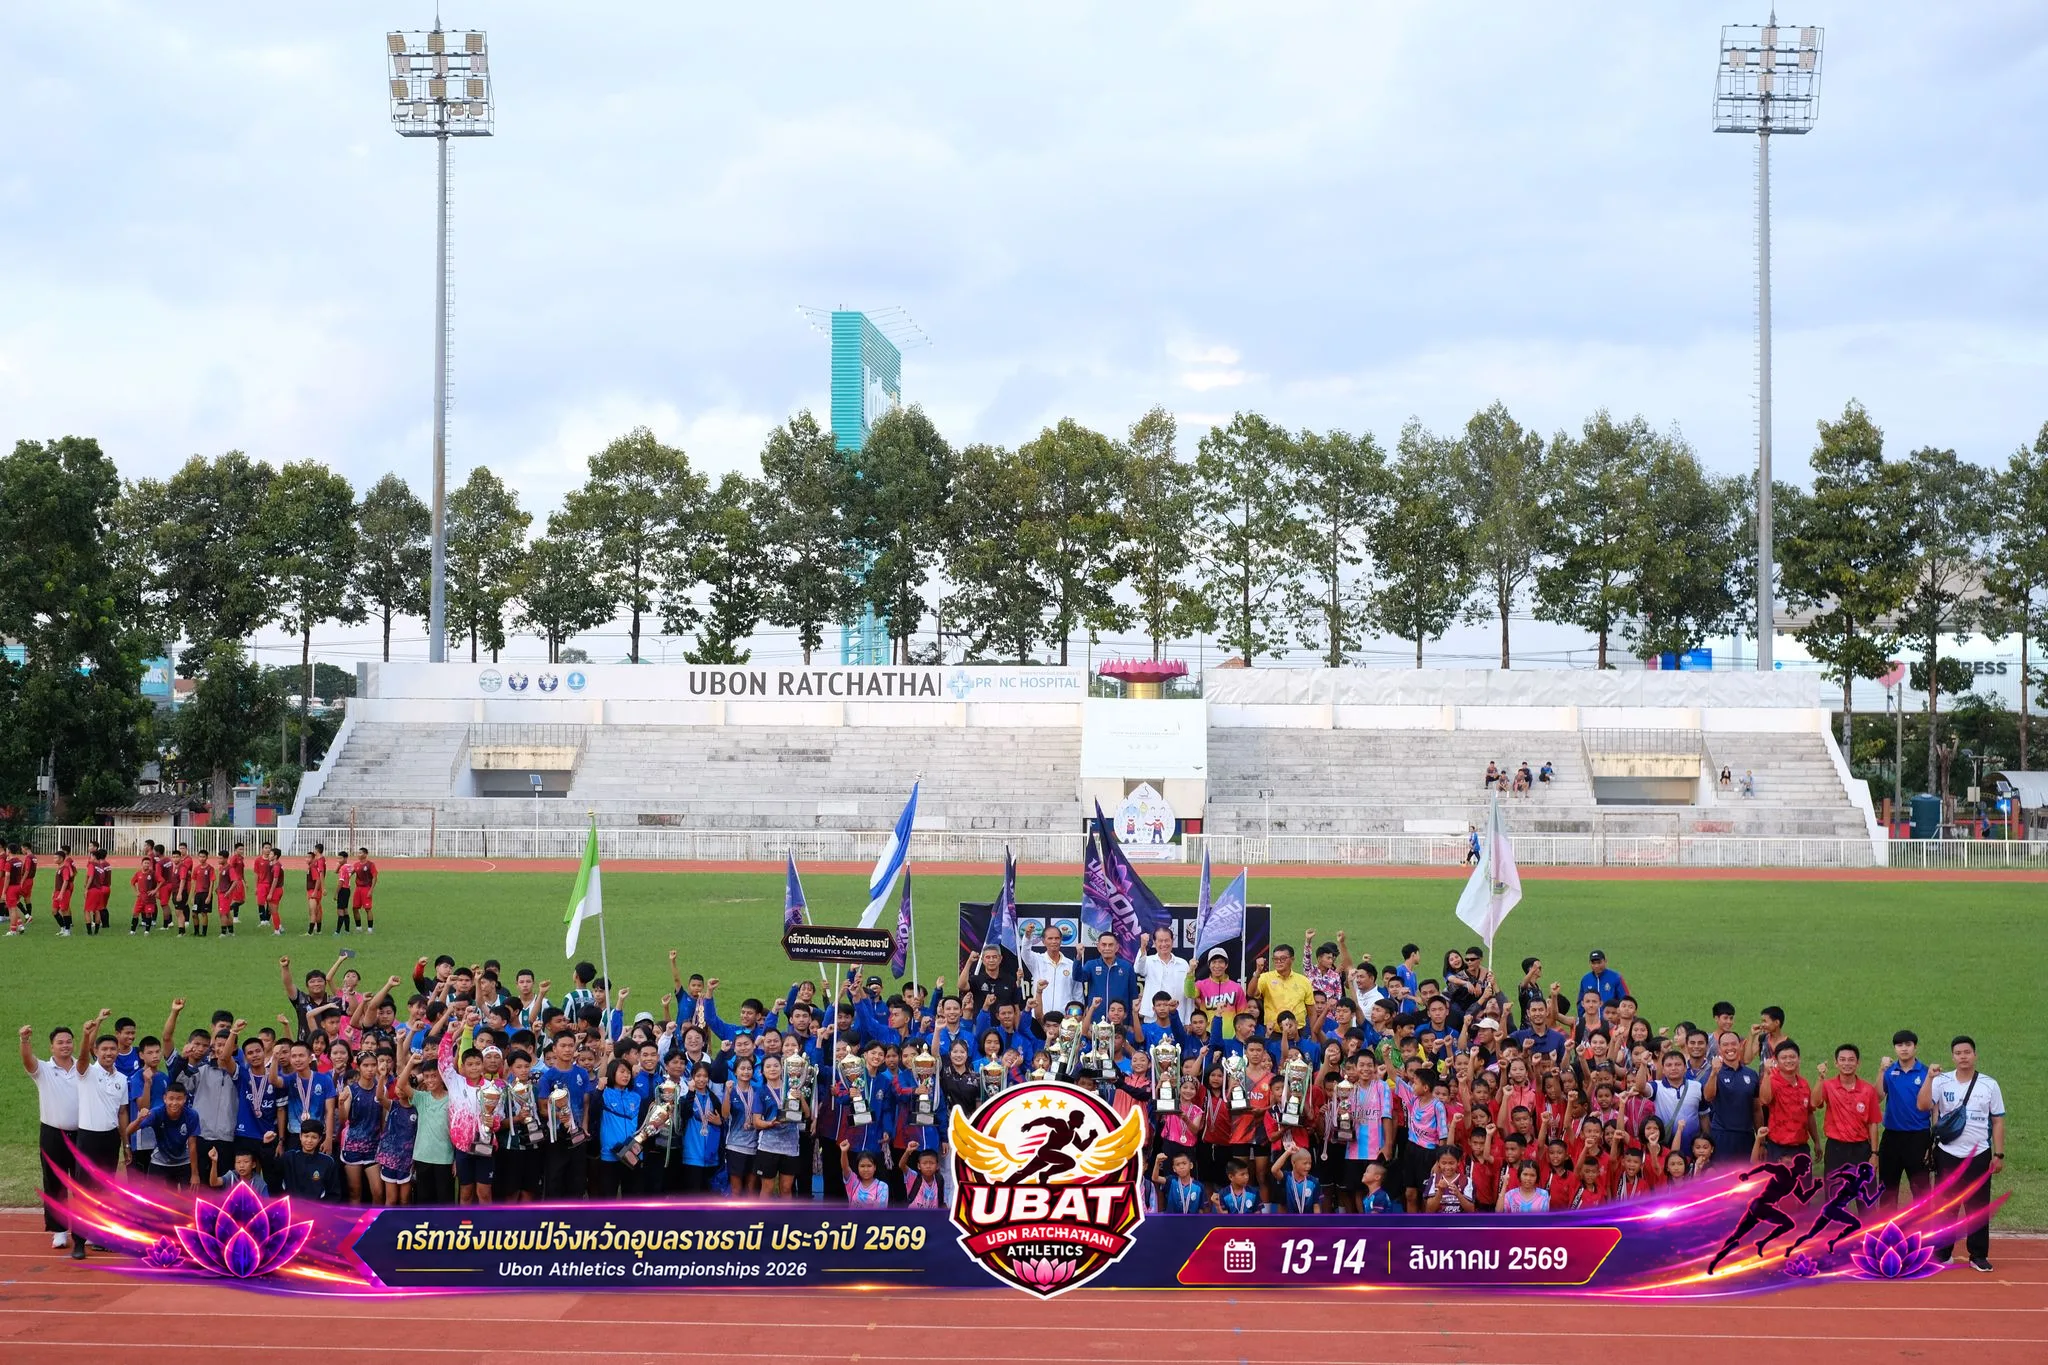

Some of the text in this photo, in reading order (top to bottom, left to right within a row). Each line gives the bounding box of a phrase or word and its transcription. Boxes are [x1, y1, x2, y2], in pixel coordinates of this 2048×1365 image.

[688, 671, 942, 697] UBON RATCHATHA
[1020, 677, 1080, 689] HOSPITAL
